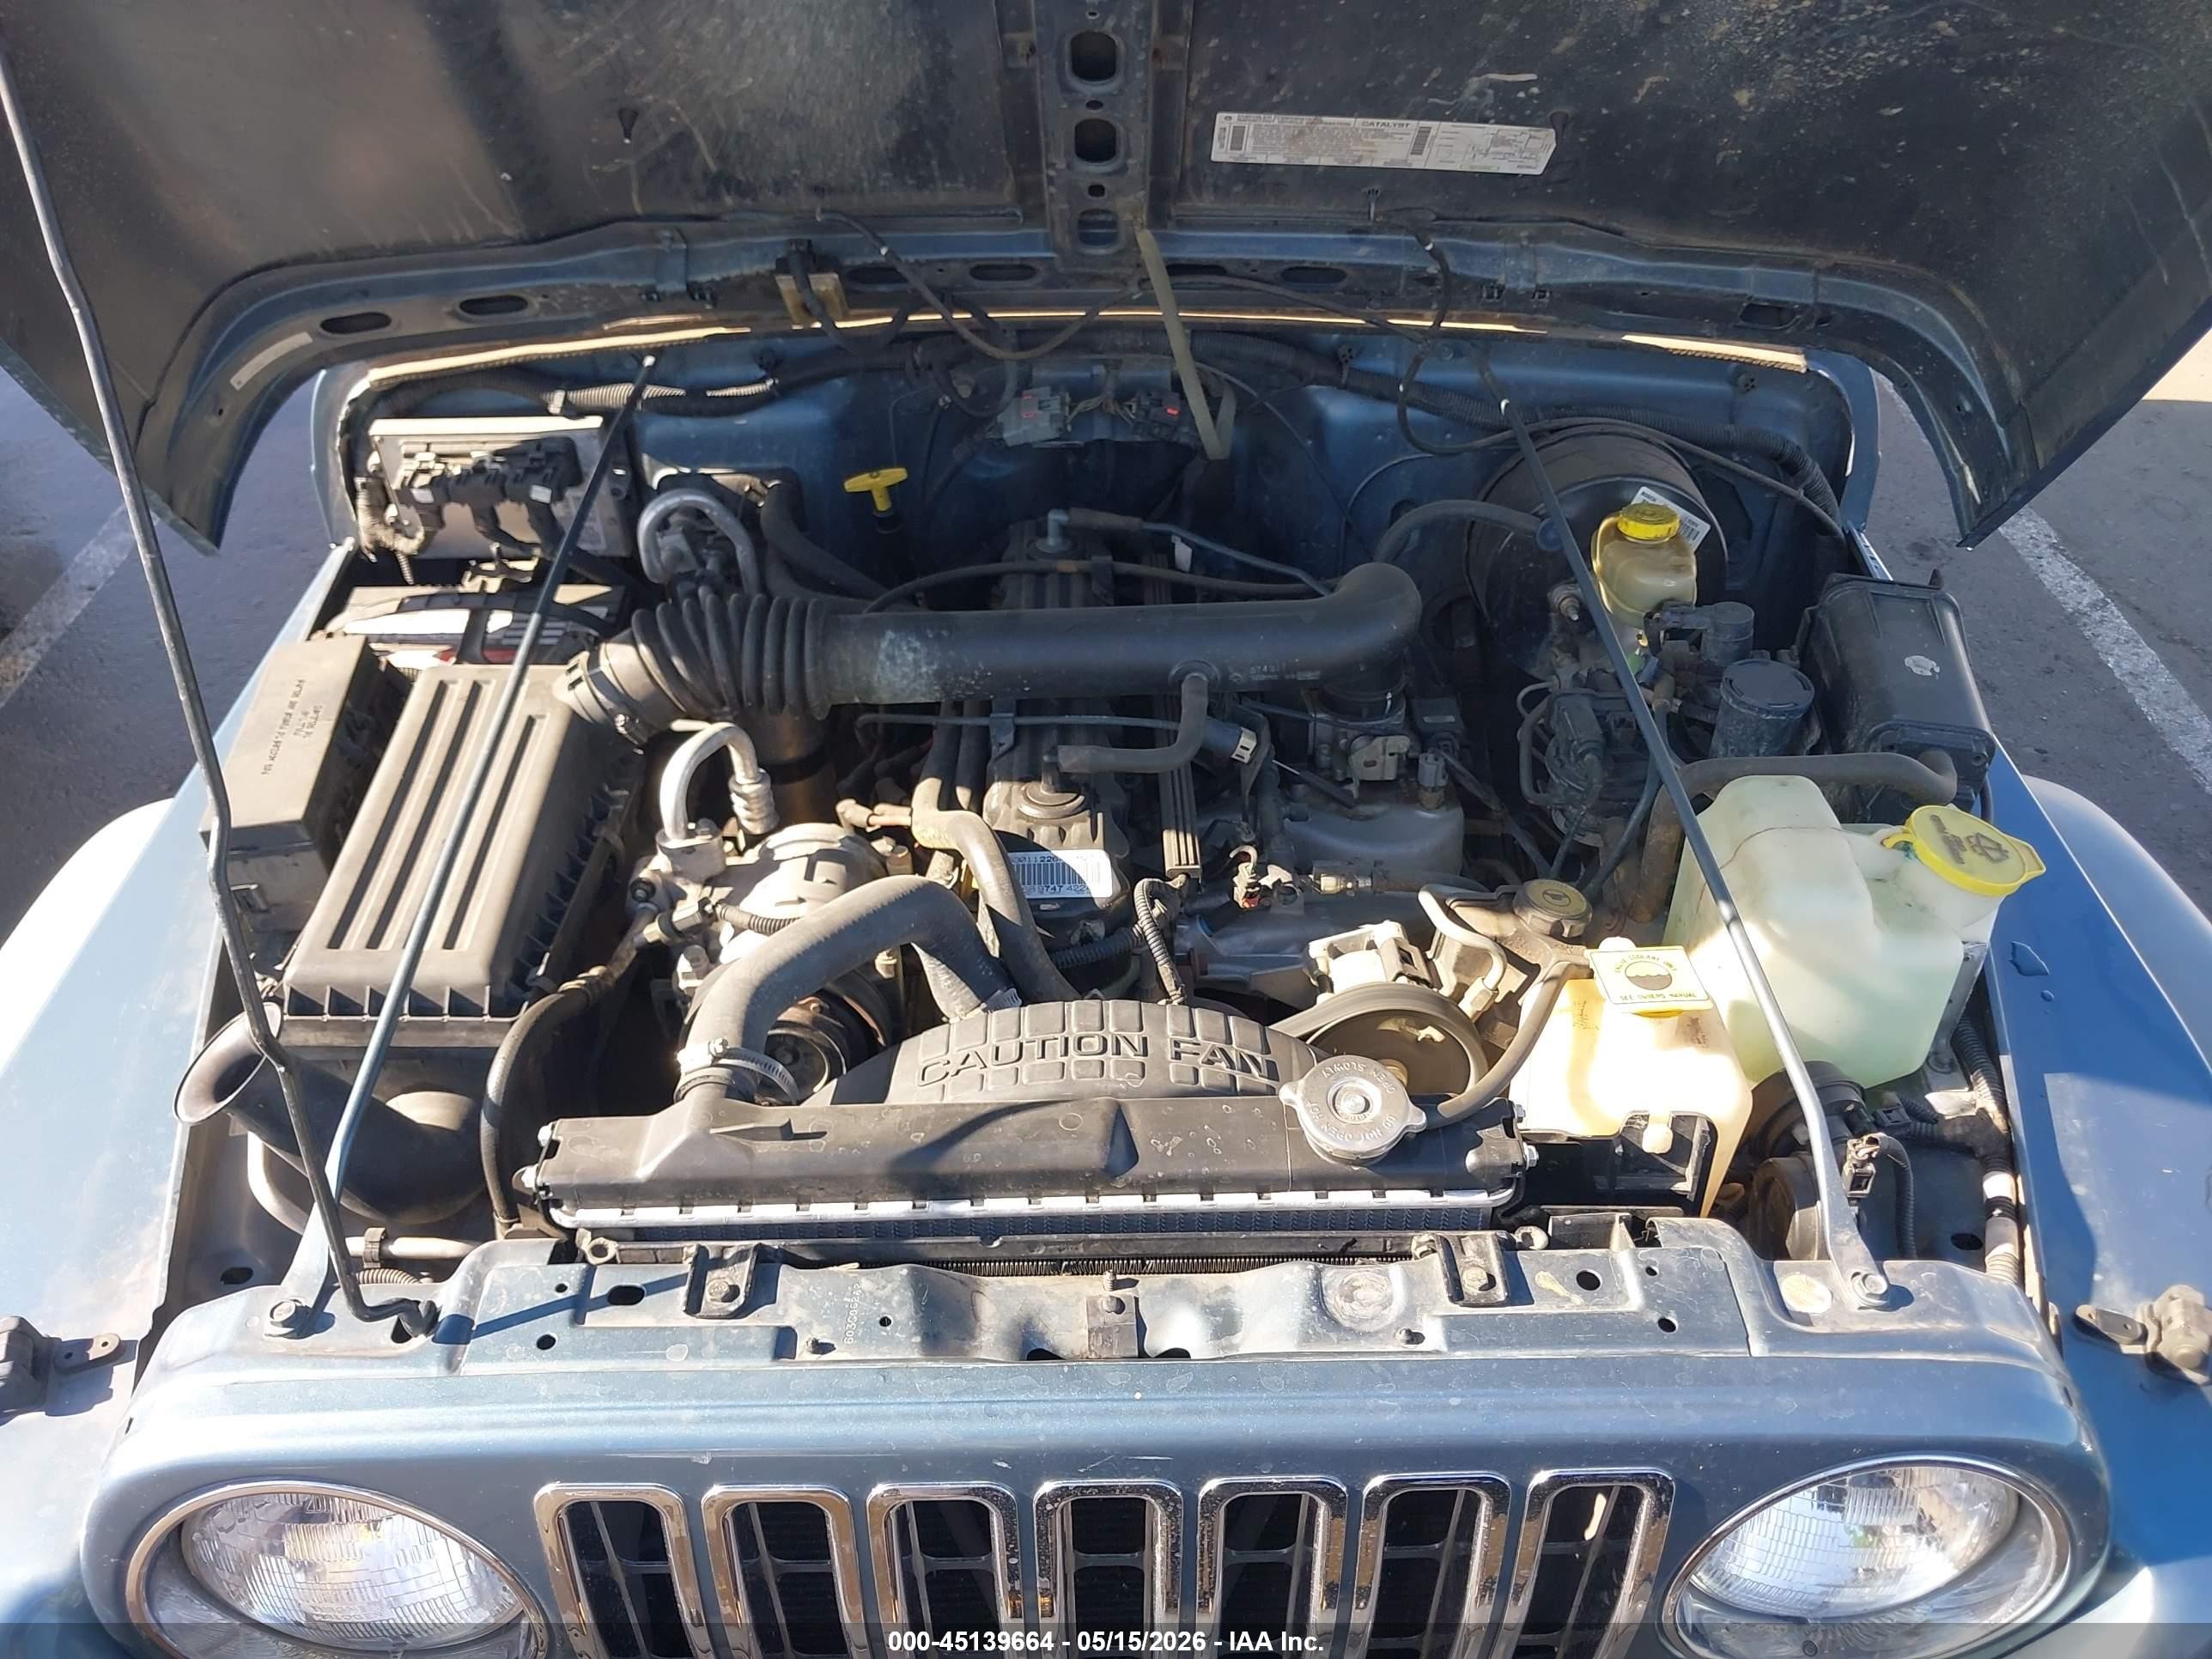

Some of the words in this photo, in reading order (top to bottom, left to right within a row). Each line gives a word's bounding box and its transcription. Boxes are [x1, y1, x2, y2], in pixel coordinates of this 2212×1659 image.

[918, 1033, 1147, 1087] CAUTION
[1170, 1038, 1279, 1083] FAN
[1322, 1061, 1367, 1079] SLOWLY
